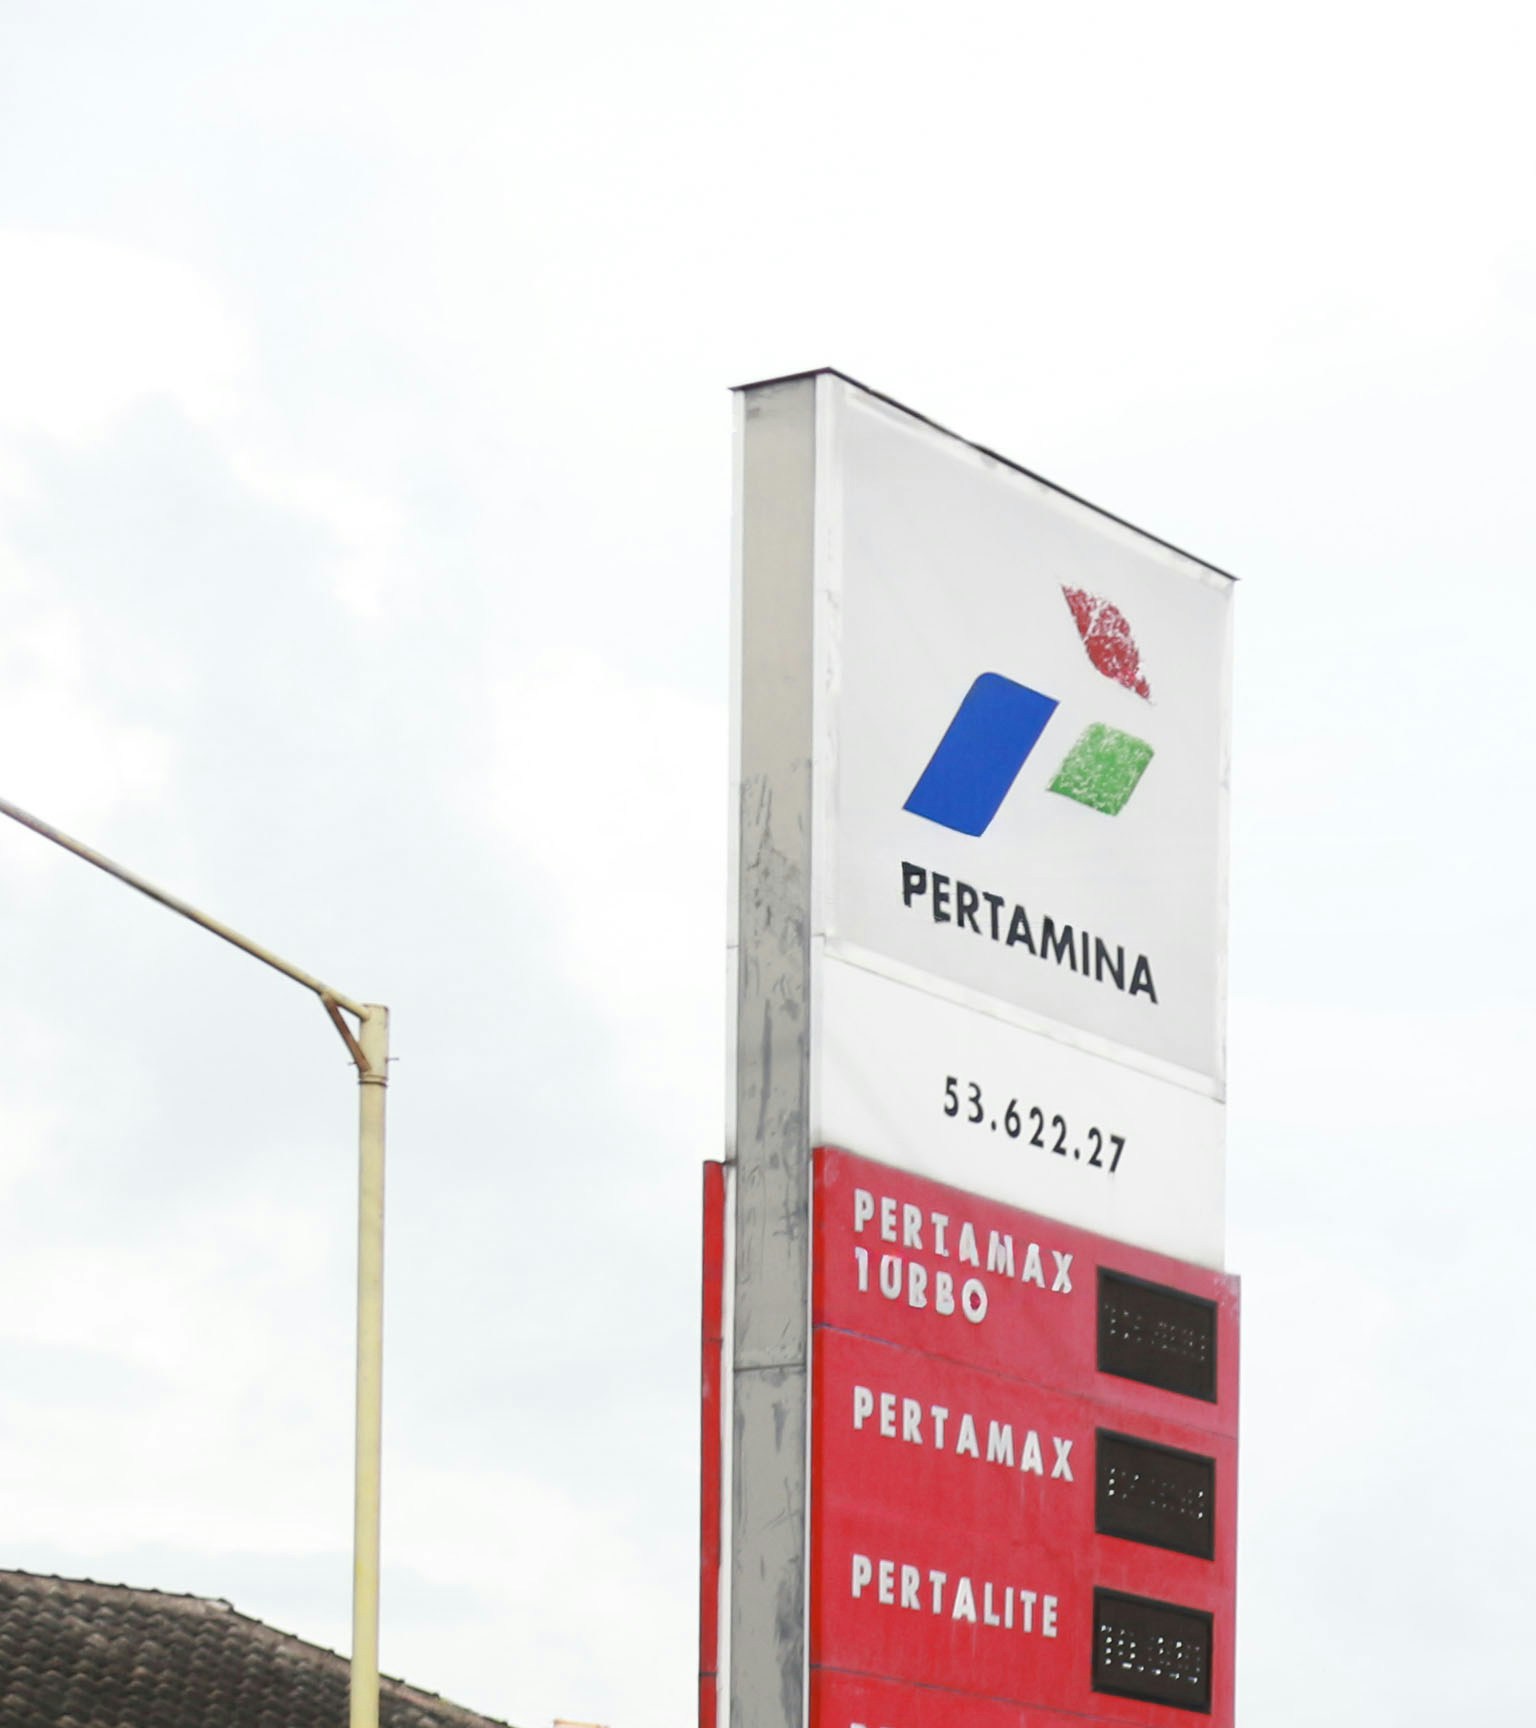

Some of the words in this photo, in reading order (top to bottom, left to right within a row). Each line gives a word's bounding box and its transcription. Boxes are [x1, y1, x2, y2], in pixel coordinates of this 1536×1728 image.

[901, 861, 1159, 1004] PERTAMINA
[942, 1076, 1126, 1175] 53.622.27
[853, 1188, 1074, 1296] PERTAMAX
[852, 1385, 1074, 1483] PERTAMAX
[851, 1553, 1059, 1638] PERTALITE
